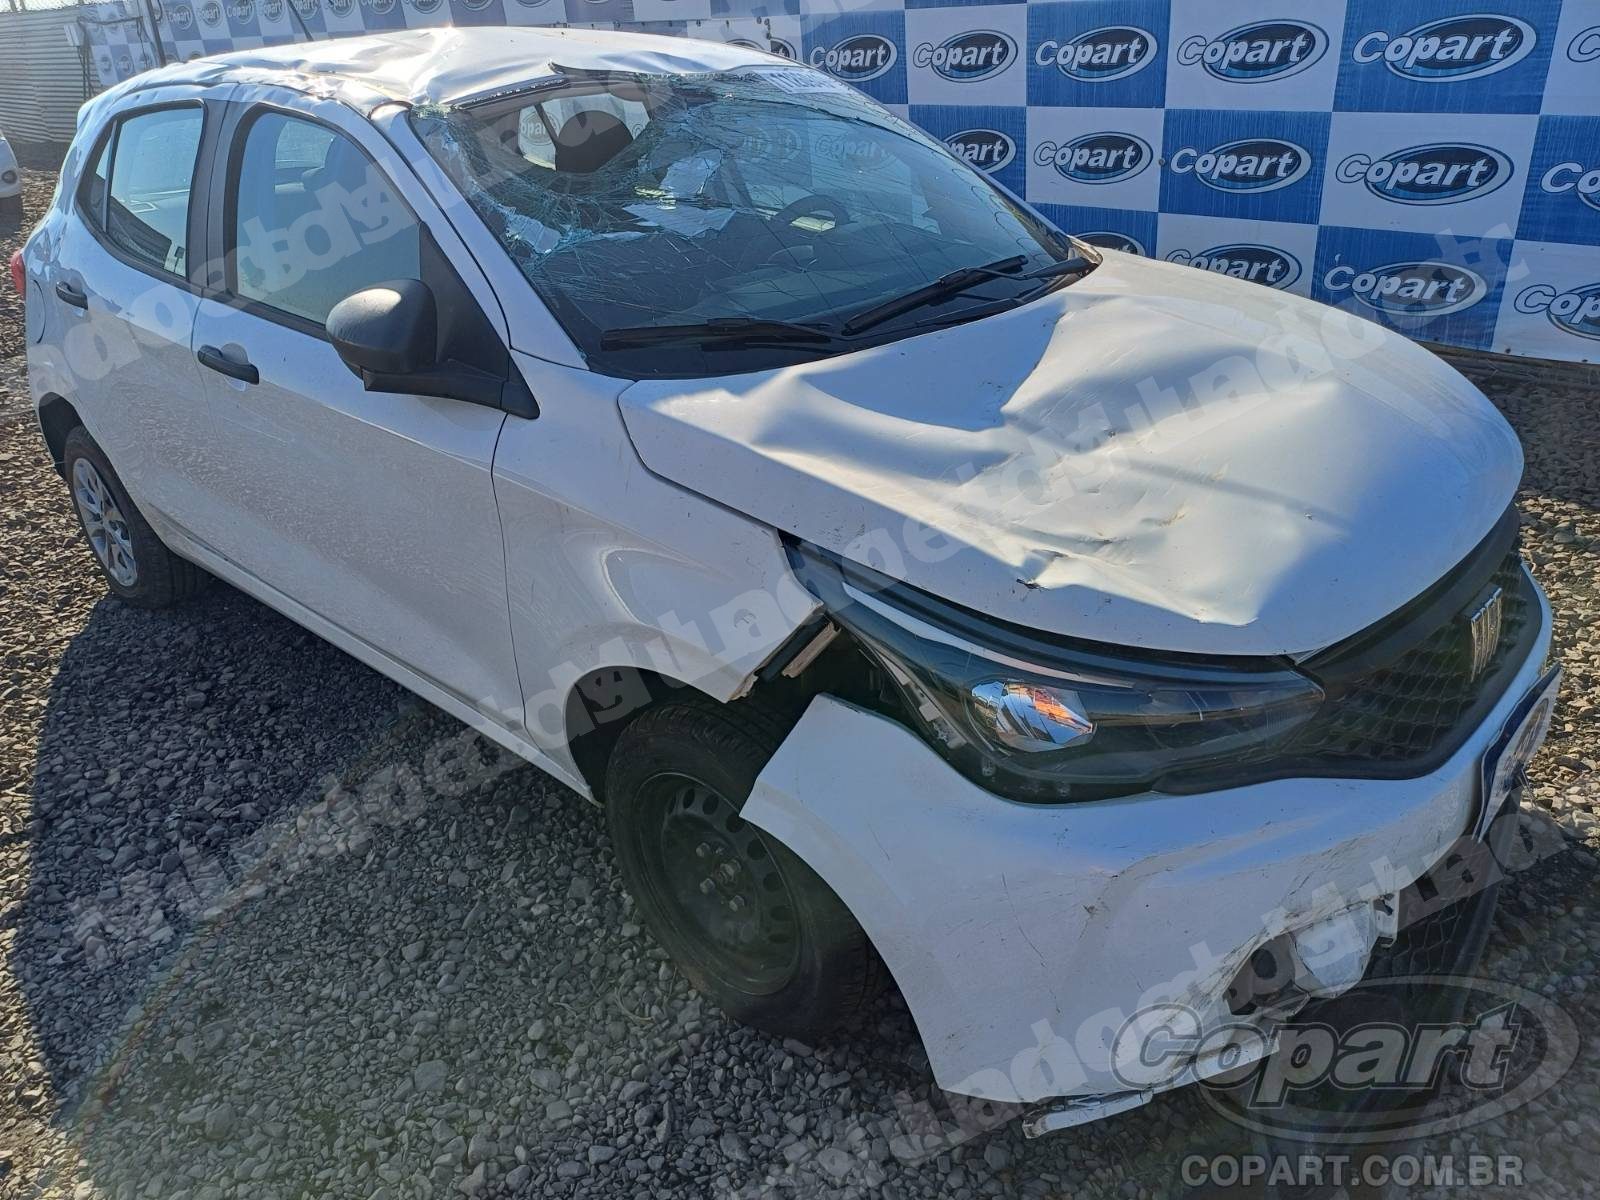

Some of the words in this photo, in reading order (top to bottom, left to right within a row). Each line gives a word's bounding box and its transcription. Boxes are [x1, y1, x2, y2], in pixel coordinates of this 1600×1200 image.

[809, 45, 886, 72] Copart
[912, 41, 1003, 71] Copart
[1034, 36, 1142, 71] Copart
[1176, 33, 1310, 70] Copart
[1351, 26, 1516, 70] Copart
[949, 140, 1003, 161] part
[1034, 141, 1138, 172] Copart
[1170, 147, 1294, 180] Copart
[1335, 153, 1490, 190] Copart
[1323, 266, 1466, 303] Copart
